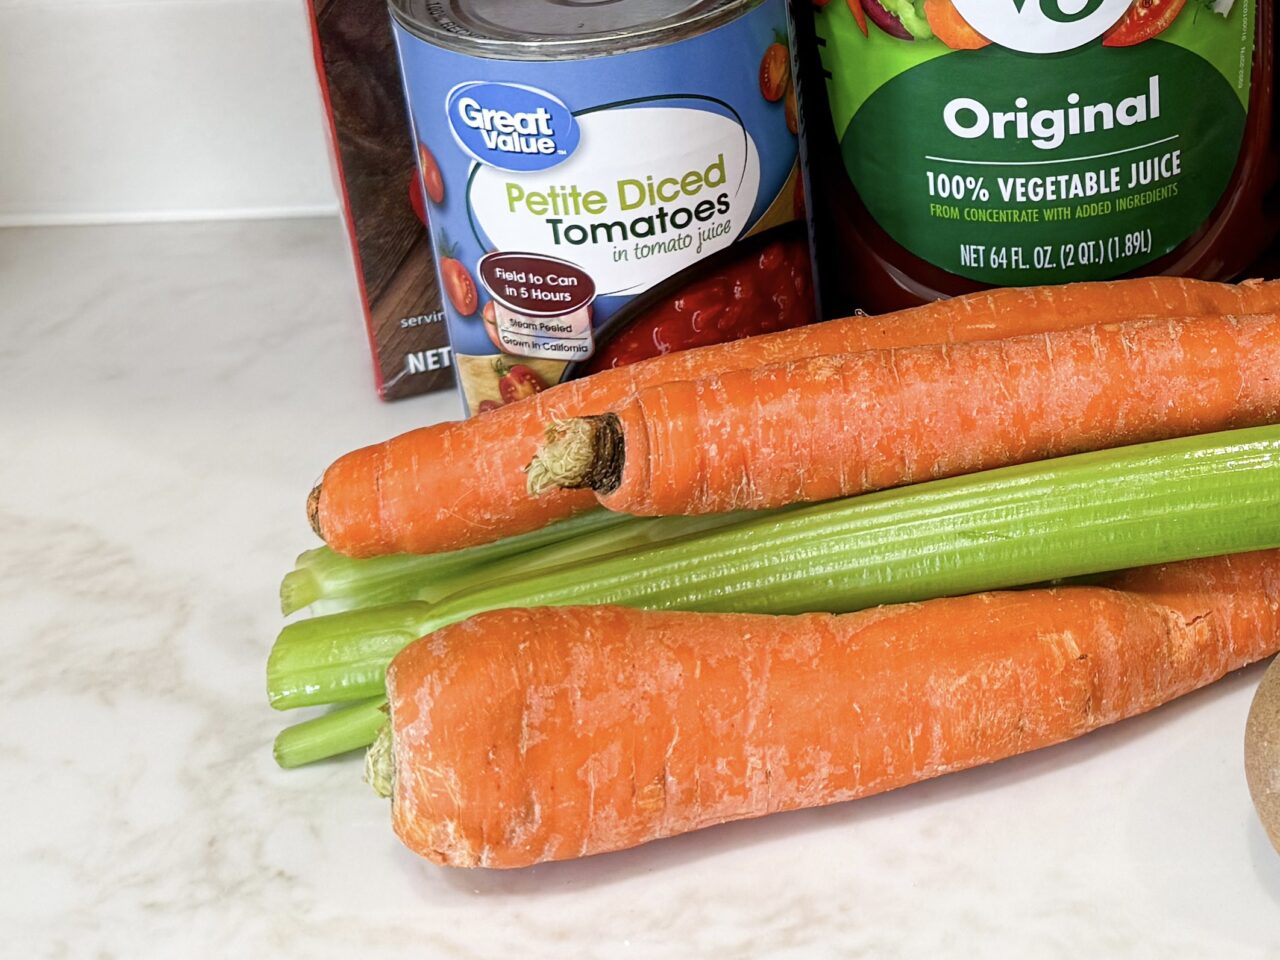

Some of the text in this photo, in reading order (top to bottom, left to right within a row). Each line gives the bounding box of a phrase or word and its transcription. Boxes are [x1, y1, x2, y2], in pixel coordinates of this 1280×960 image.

[458, 97, 554, 137] Great
[943, 74, 1160, 150] Original
[480, 129, 556, 155] Value
[505, 153, 726, 216] Petite Diced
[926, 149, 1181, 203] 100% VEGETABLE JUICE
[545, 192, 730, 245] Tomatoes
[930, 182, 1179, 223] FROM CONCENTRATE WITH ADDED INGREDIENTS
[613, 218, 731, 263] in tomato juice
[960, 228, 1152, 270] NET 64 FL. OZ. (2 QT.) (1.89L)
[494, 267, 577, 286] Field to Can
[505, 285, 572, 302] in 5 Hours
[502, 335, 589, 353] Grown in California
[509, 317, 573, 333] Steam Peeled
[408, 347, 452, 375] NET
